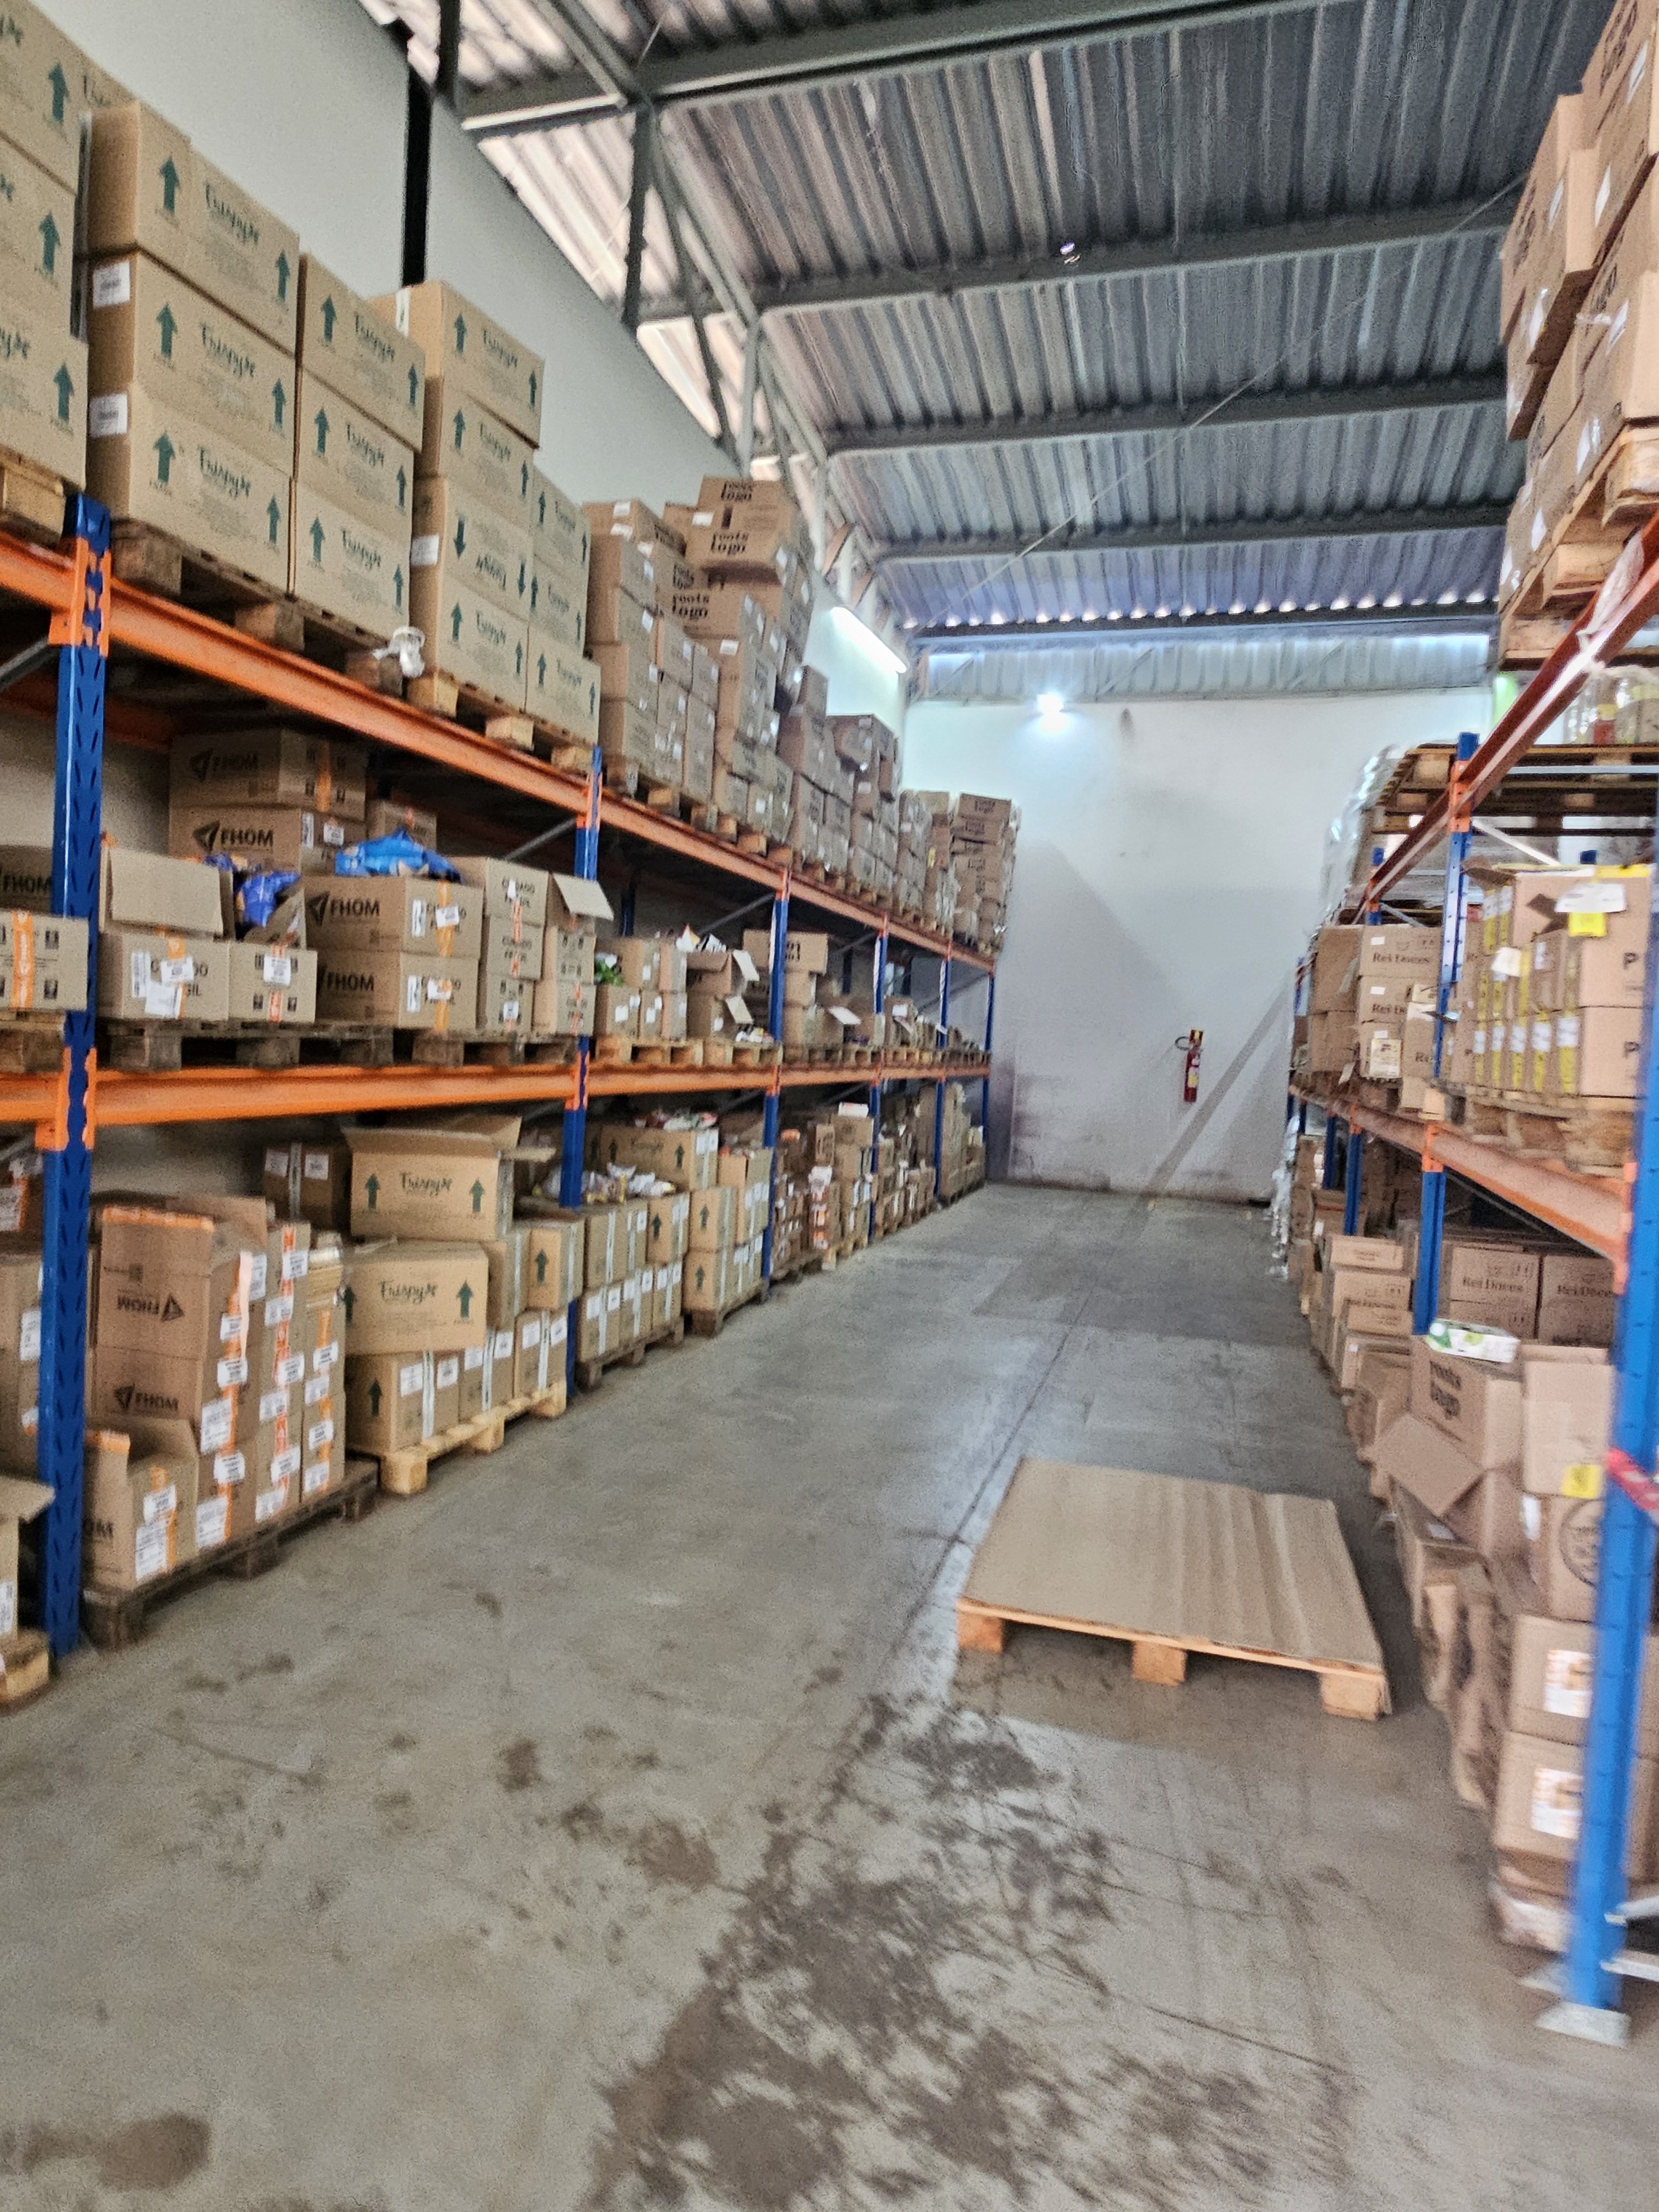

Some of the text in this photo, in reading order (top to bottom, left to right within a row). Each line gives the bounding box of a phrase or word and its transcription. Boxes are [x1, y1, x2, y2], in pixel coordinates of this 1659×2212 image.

[221, 829, 274, 848] FHOM
[330, 898, 380, 917] FHOM
[327, 972, 375, 992] FHOM
[135, 1392, 179, 1411] FHOM
